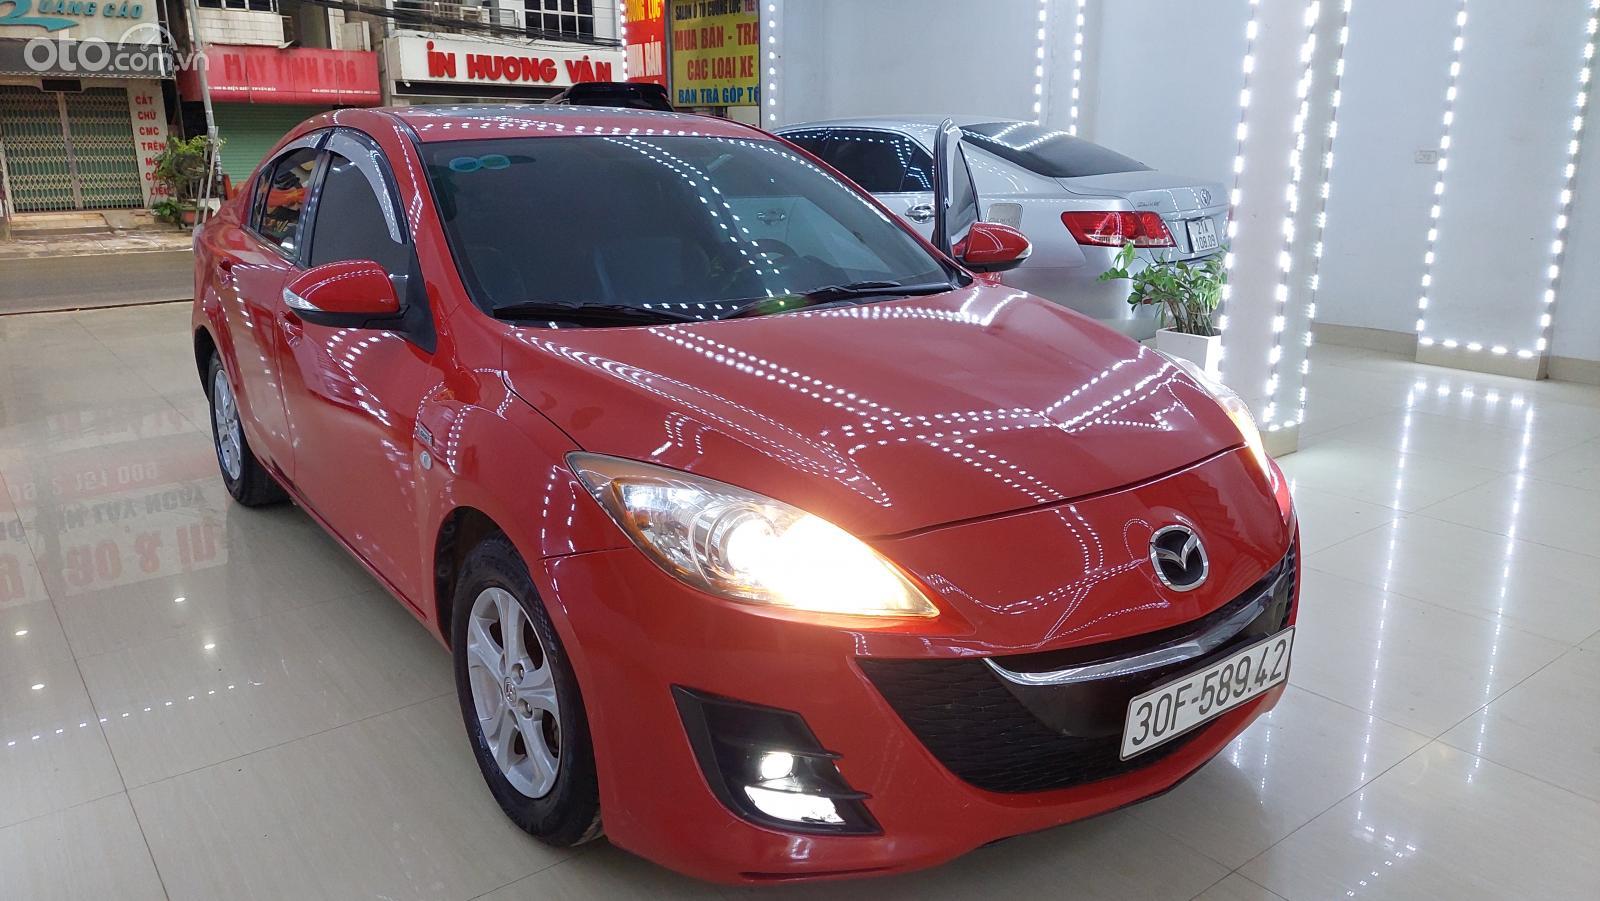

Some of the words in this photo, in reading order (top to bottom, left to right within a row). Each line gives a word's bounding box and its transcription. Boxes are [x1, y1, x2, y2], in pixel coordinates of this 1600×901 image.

[674, 29, 698, 51] MUA
[740, 55, 754, 77] XE
[1132, 639, 1287, 746] 30F-589.42
